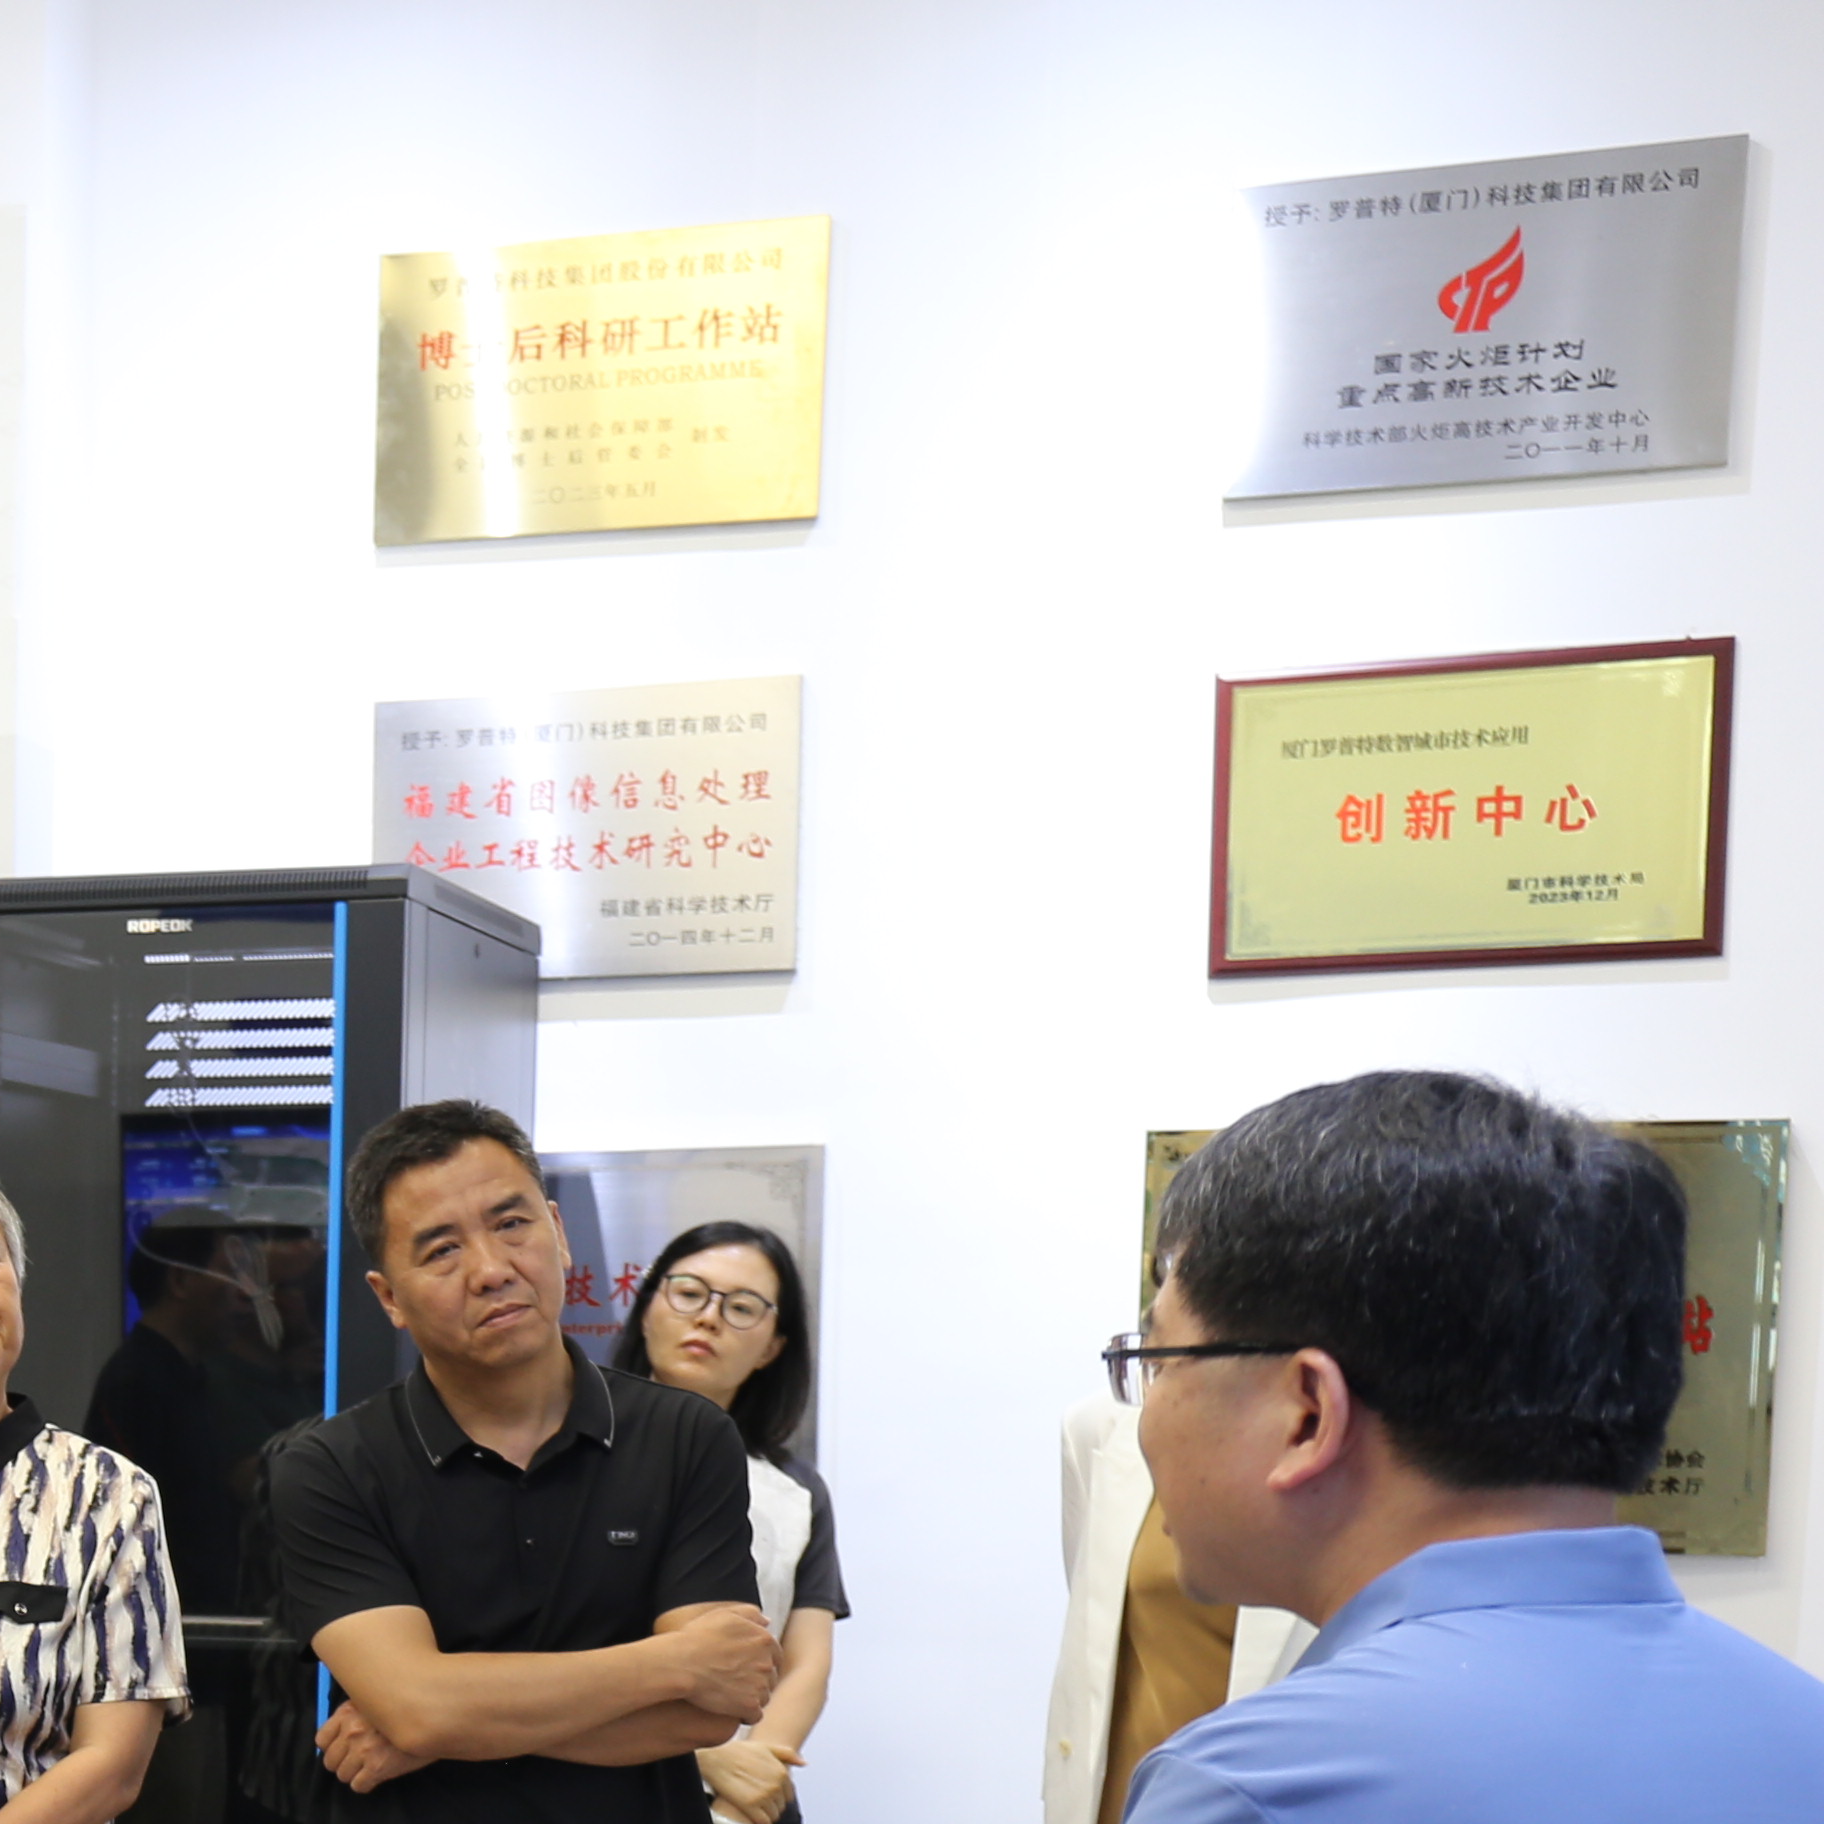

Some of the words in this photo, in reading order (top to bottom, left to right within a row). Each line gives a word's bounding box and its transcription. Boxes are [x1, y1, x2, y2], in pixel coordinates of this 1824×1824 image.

[428, 247, 783, 298] 罗科技集团股份有限公司
[616, 358, 765, 387] PROGRAMME
[1373, 339, 1586, 376] 国家火炬计划
[1336, 367, 1619, 409] 重点高新技术企业
[403, 768, 772, 820] 福建省图像信息处理
[1335, 784, 1598, 844] 创新中心
[405, 824, 772, 873] 企业工程技术研究中心
[127, 918, 193, 934] ROPEOK
[600, 893, 774, 919] 福建省科学技术厅
